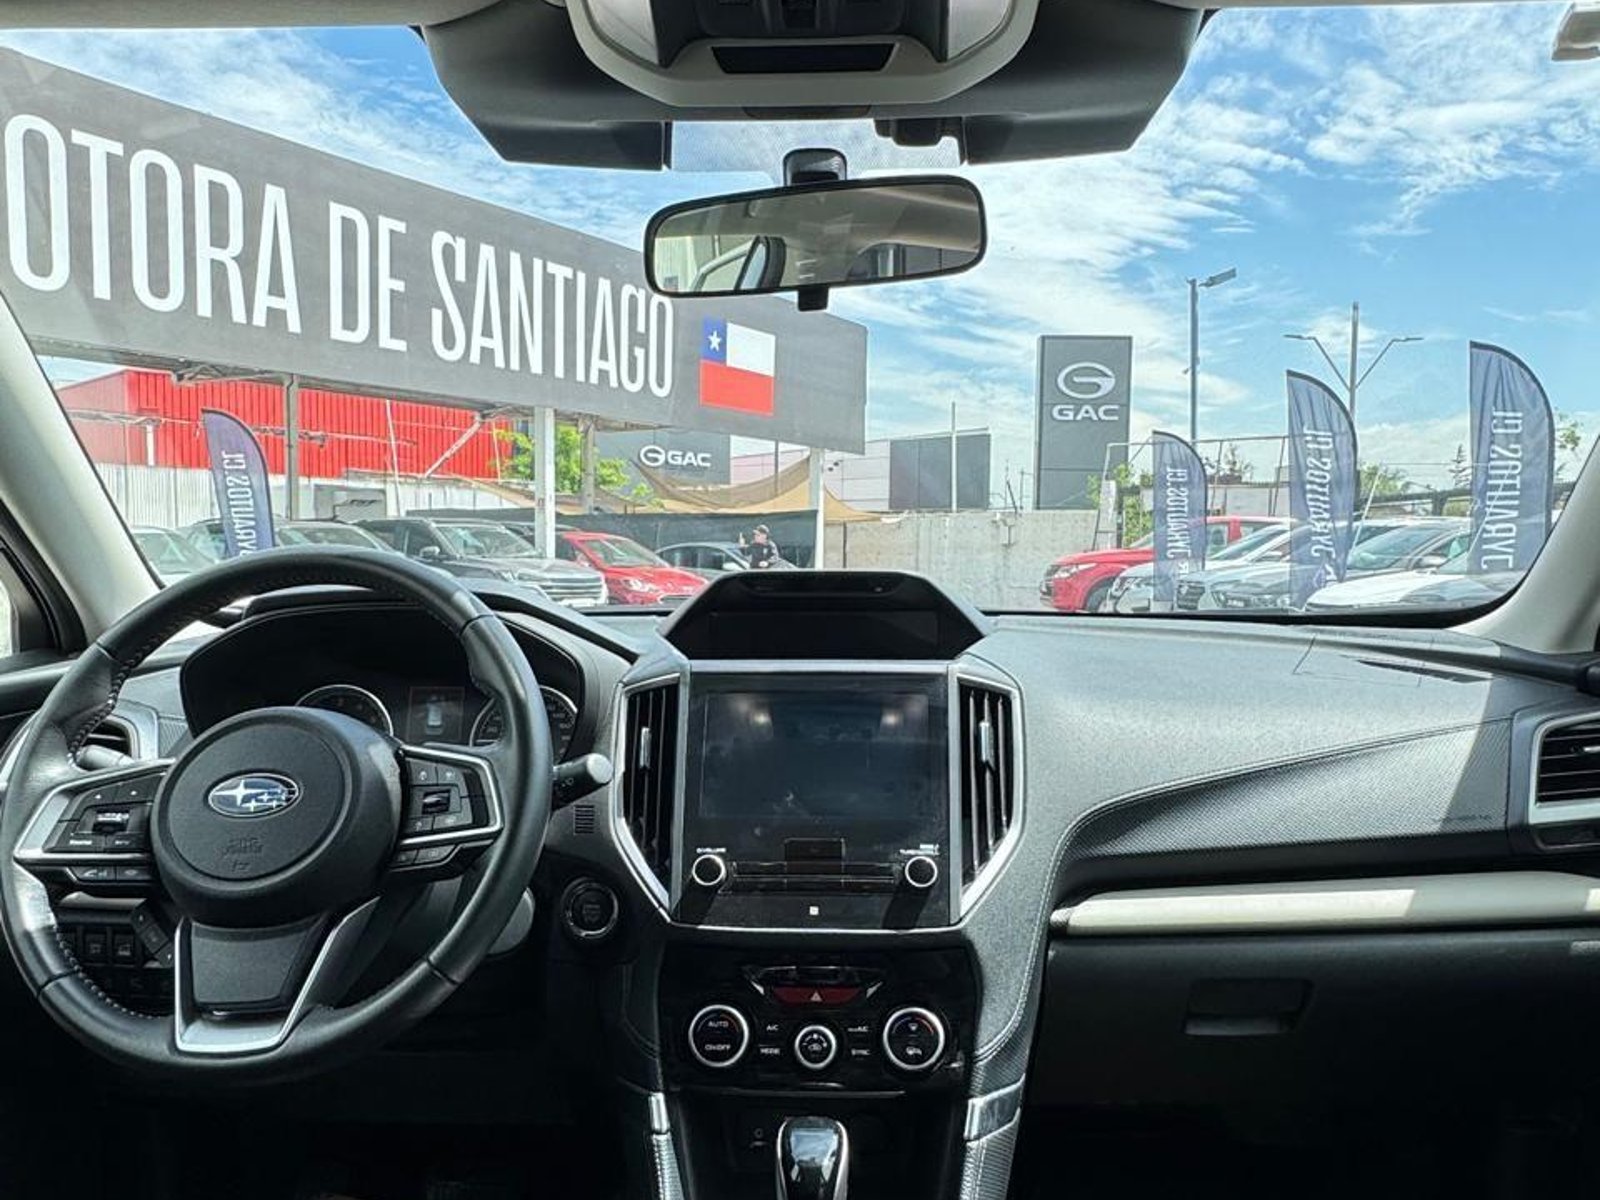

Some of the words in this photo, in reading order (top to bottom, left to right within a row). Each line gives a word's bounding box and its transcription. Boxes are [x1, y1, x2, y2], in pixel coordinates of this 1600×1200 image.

[4, 113, 302, 335] OTORA
[328, 201, 408, 352] DE
[430, 231, 674, 398] SANTIAGO
[1052, 404, 1120, 421] GAC
[667, 450, 712, 467] GAC
